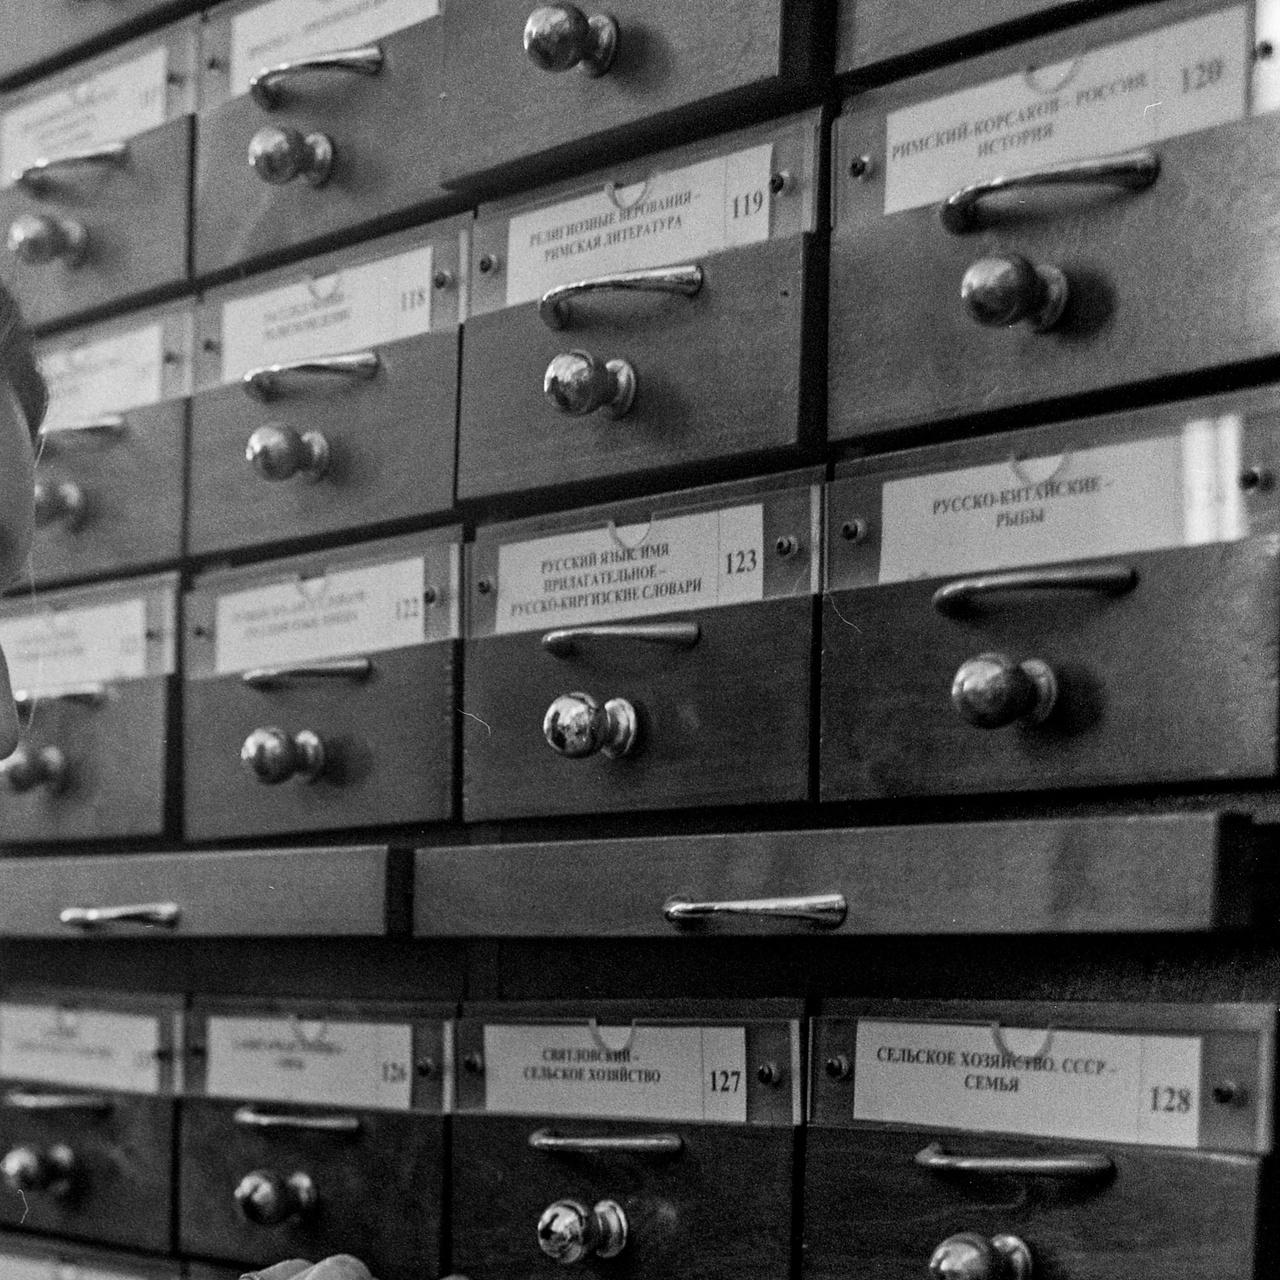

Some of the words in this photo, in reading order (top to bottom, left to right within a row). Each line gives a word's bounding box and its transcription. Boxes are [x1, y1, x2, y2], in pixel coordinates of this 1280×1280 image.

[1180, 59, 1222, 94] 120
[891, 98, 1060, 161] РИМСКИЙ-КОРСАКОВ
[1075, 71, 1148, 108] РОССИЯ
[977, 121, 1054, 158] ИСТОРИЯ
[530, 211, 614, 247] РЕЛИГИОЗНЫЕ
[620, 191, 691, 222] ВЕРОВАНИЯ
[732, 190, 763, 219] 119
[544, 235, 601, 262] РИМСКАЯ
[604, 215, 682, 247] ЛИТЕРАТУРА
[932, 476, 1100, 515] РУССКО-КИТАЙСКИЕ
[995, 509, 1045, 528] РЫБЫ
[541, 555, 597, 574] РУССКИЙ
[641, 543, 669, 560] ИМЯ
[726, 550, 757, 575] 123
[544, 564, 657, 592] ПРИЛАГАТЕЛЬНОЕ
[511, 589, 639, 616] РУССКО-КИРГИЗСКИЕ
[642, 578, 702, 599] СЛОВАРИ
[524, 1067, 585, 1081] СЕЛЬСКОЕ
[588, 1067, 661, 1083] ХОЗЯЙСТВО
[877, 1046, 956, 1066] СЕЛЬСКОЕ
[1062, 1057, 1106, 1075] СССР
[710, 1071, 741, 1093] 127
[964, 1074, 1019, 1093] СЕМЬЯ
[1149, 1086, 1192, 1113] 128
